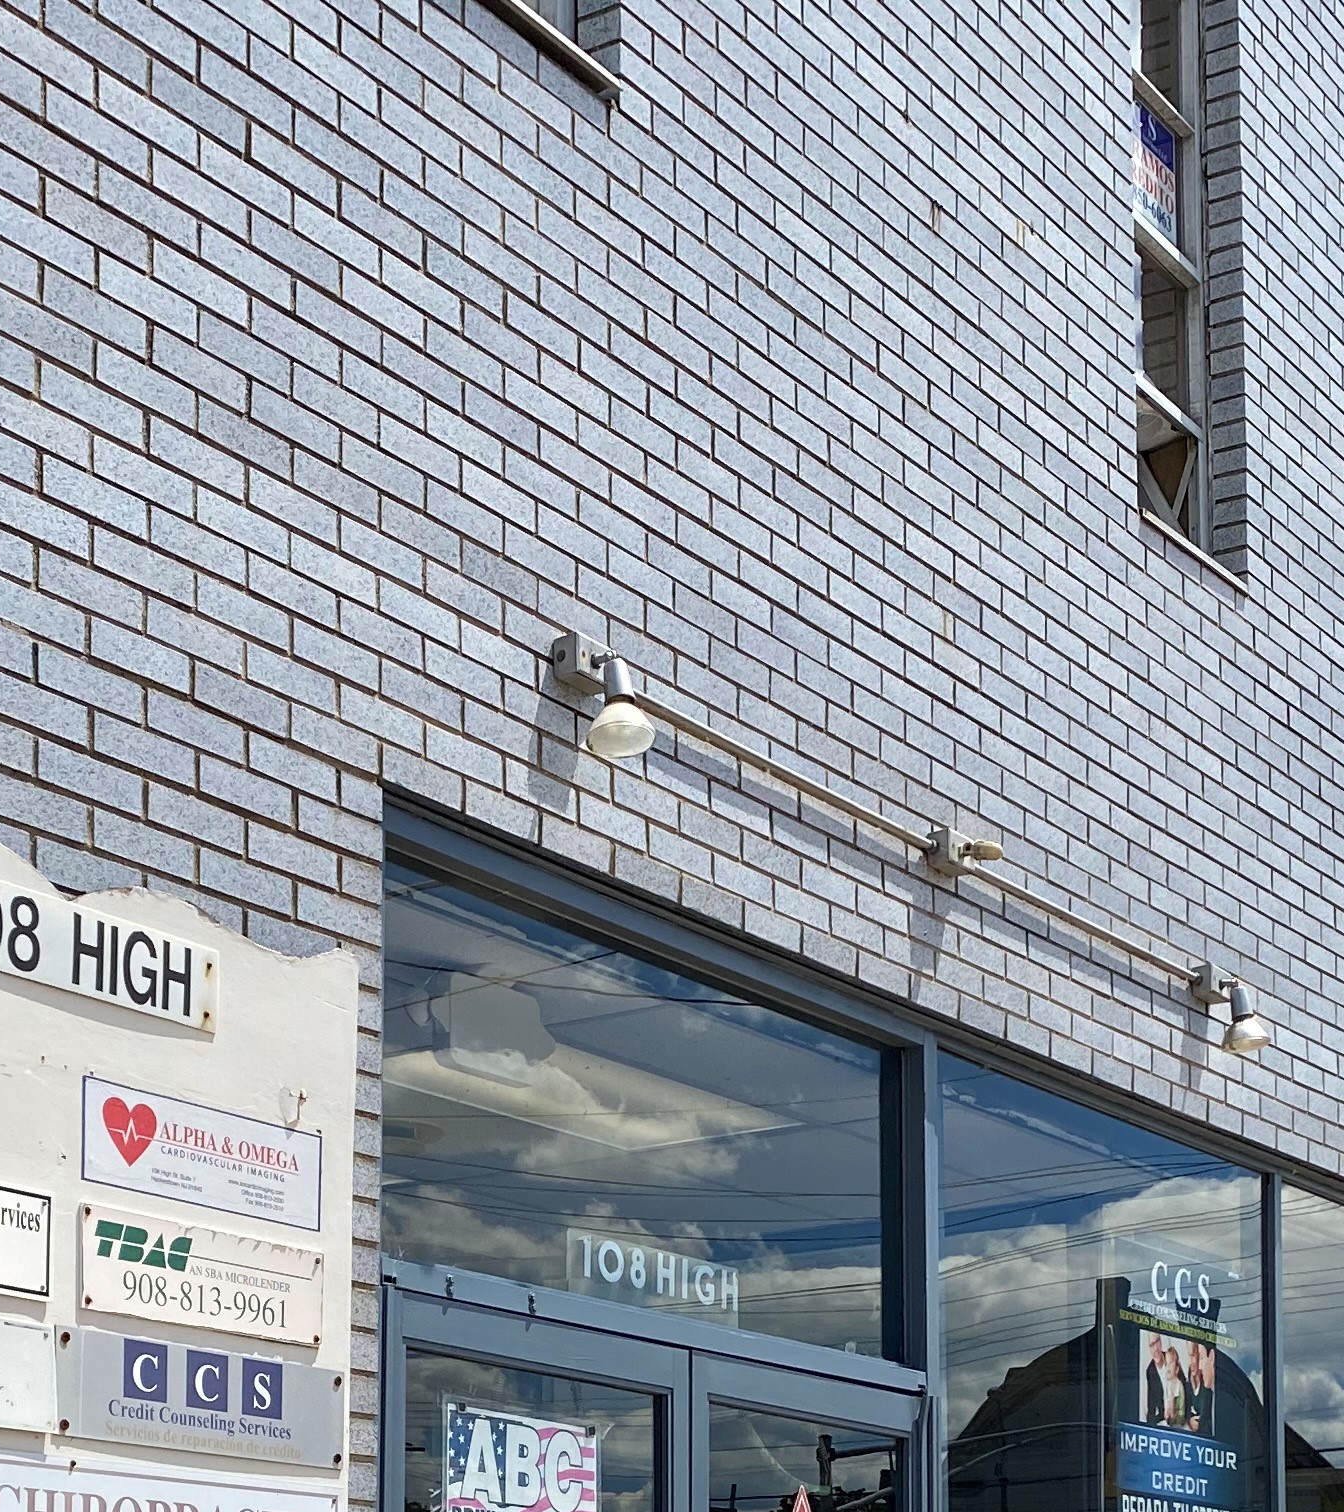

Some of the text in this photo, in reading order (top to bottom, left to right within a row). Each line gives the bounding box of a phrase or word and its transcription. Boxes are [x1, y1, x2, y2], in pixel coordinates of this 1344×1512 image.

[72, 912, 192, 1017] HIGH
[159, 1122, 299, 1171] ALPHA & OMEGA
[160, 1146, 285, 1183] CARDIOVASCULAR IMAGING
[189, 1265, 291, 1293] AN SBA MICROLENDER
[576, 1235, 738, 1312] 108 HIGH
[123, 1270, 287, 1328] 908-813-9961
[106, 1421, 160, 1443] Servicios
[163, 1429, 178, 1444] de
[246, 1441, 260, 1455] de
[108, 1399, 292, 1440] Credit Counseling Services
[1120, 1431, 1237, 1471] IMPROVE YOUR
[1152, 1471, 1208, 1496] CREDIT
